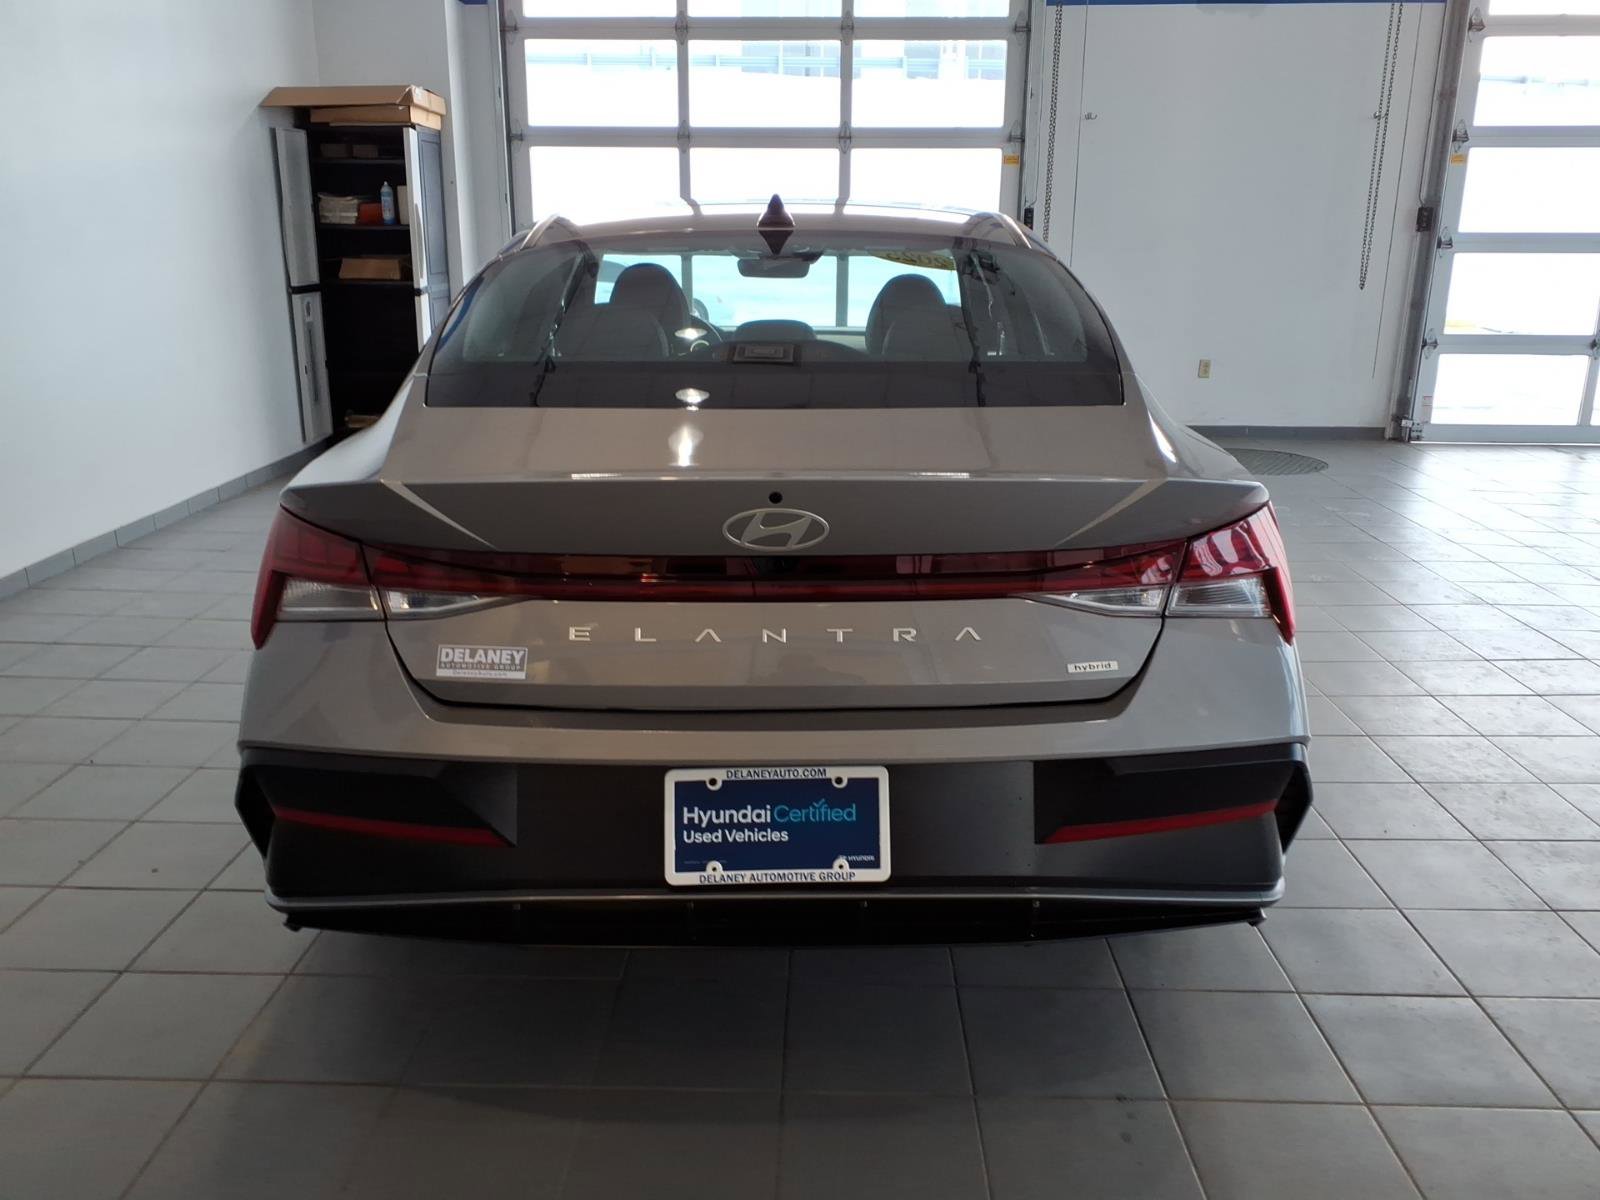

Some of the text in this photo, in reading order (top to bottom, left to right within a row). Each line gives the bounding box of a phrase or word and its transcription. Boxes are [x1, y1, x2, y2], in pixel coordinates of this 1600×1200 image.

[568, 626, 982, 643] ELANTRA
[440, 648, 525, 664] DELANEY
[1074, 662, 1112, 673] hybrid
[726, 768, 827, 779] DELANEYAUTO.COM
[683, 800, 857, 828] Hyundai Certified
[683, 828, 789, 843] Used Vehicles
[700, 871, 856, 885] DELANEY AUTOMOTIVE GROUP
